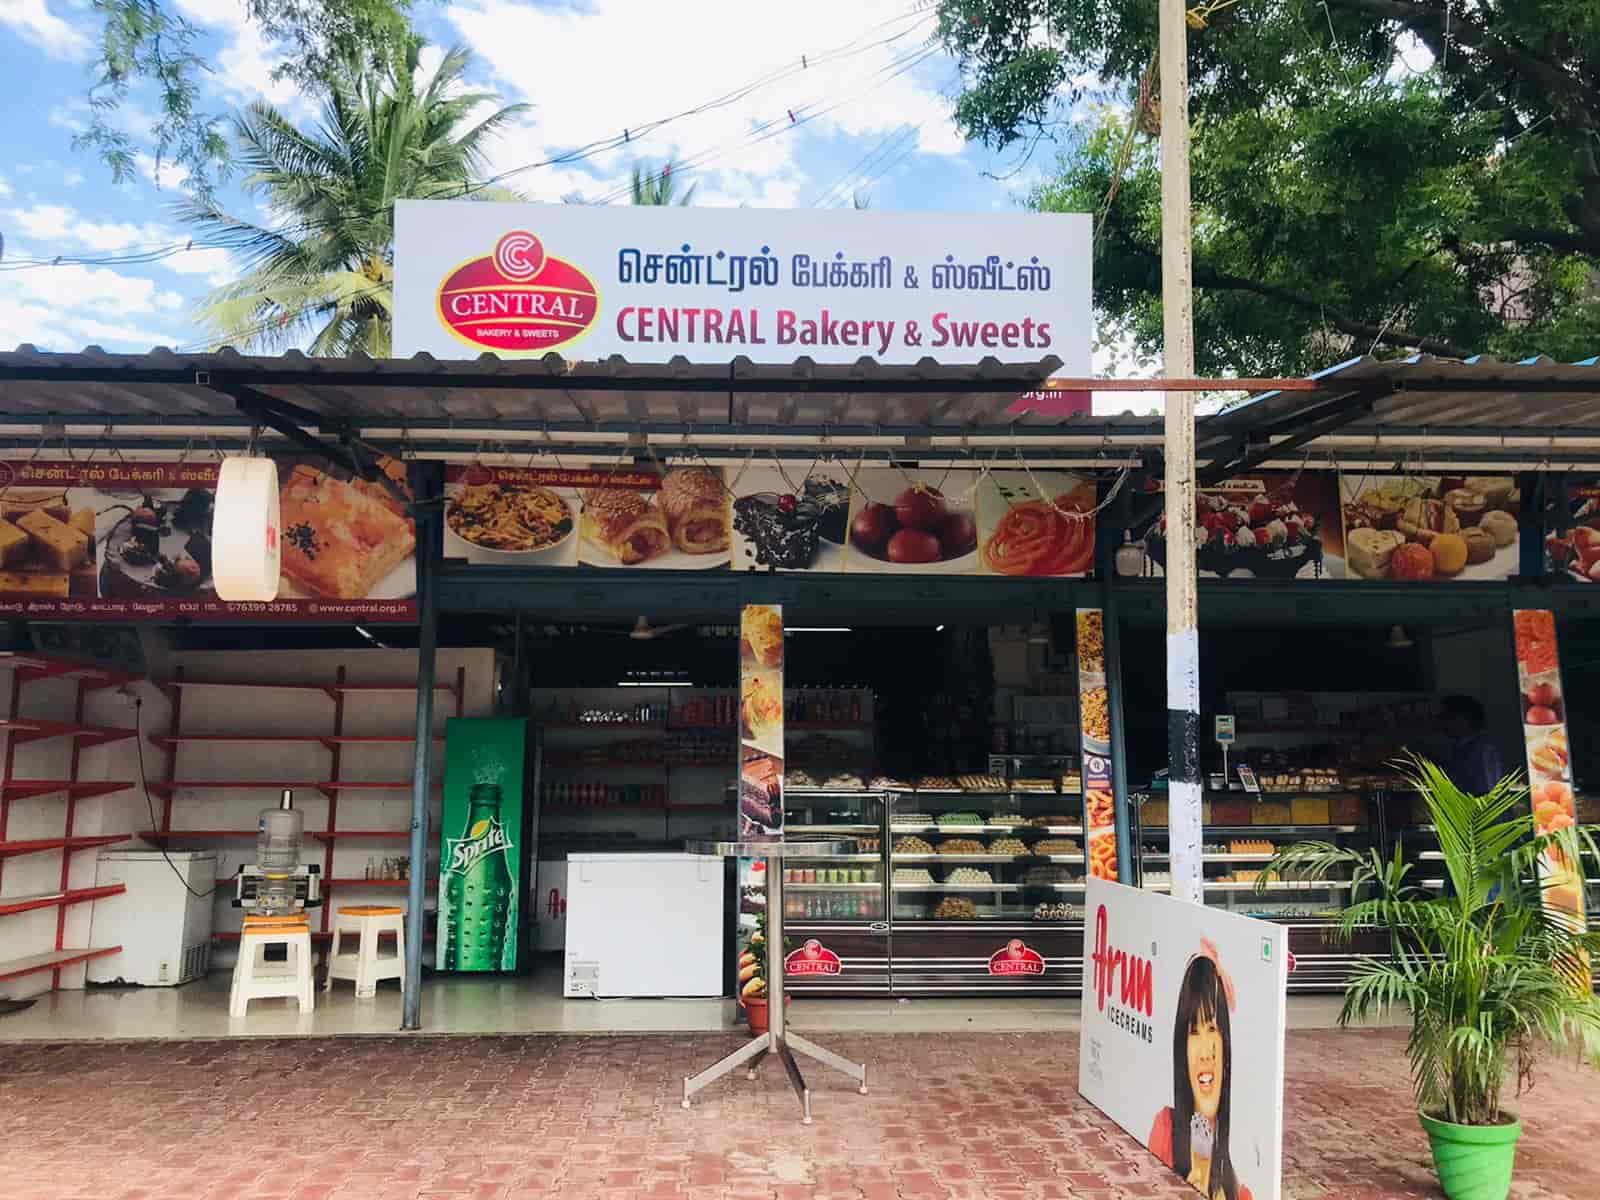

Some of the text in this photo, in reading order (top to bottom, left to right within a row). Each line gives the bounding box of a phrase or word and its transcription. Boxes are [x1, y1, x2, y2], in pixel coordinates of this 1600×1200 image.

[618, 242, 1051, 292] சென்ட்ரல் பேக்கரி & ஸ்வீட்ஸ்
[451, 293, 584, 319] CENTRAL
[475, 327, 560, 339] BAKERY & SWEETS
[616, 305, 1052, 357] CENTRAL Bakery & Sweets
[319, 603, 408, 614] www.central.org.in
[449, 823, 505, 870] Sprite
[545, 887, 567, 920] Ar
[789, 962, 837, 973] CENTRAL
[992, 962, 1041, 973] CENTRAL
[1091, 903, 1153, 1018] Arun
[1107, 1005, 1153, 1044] ICECREAMS
